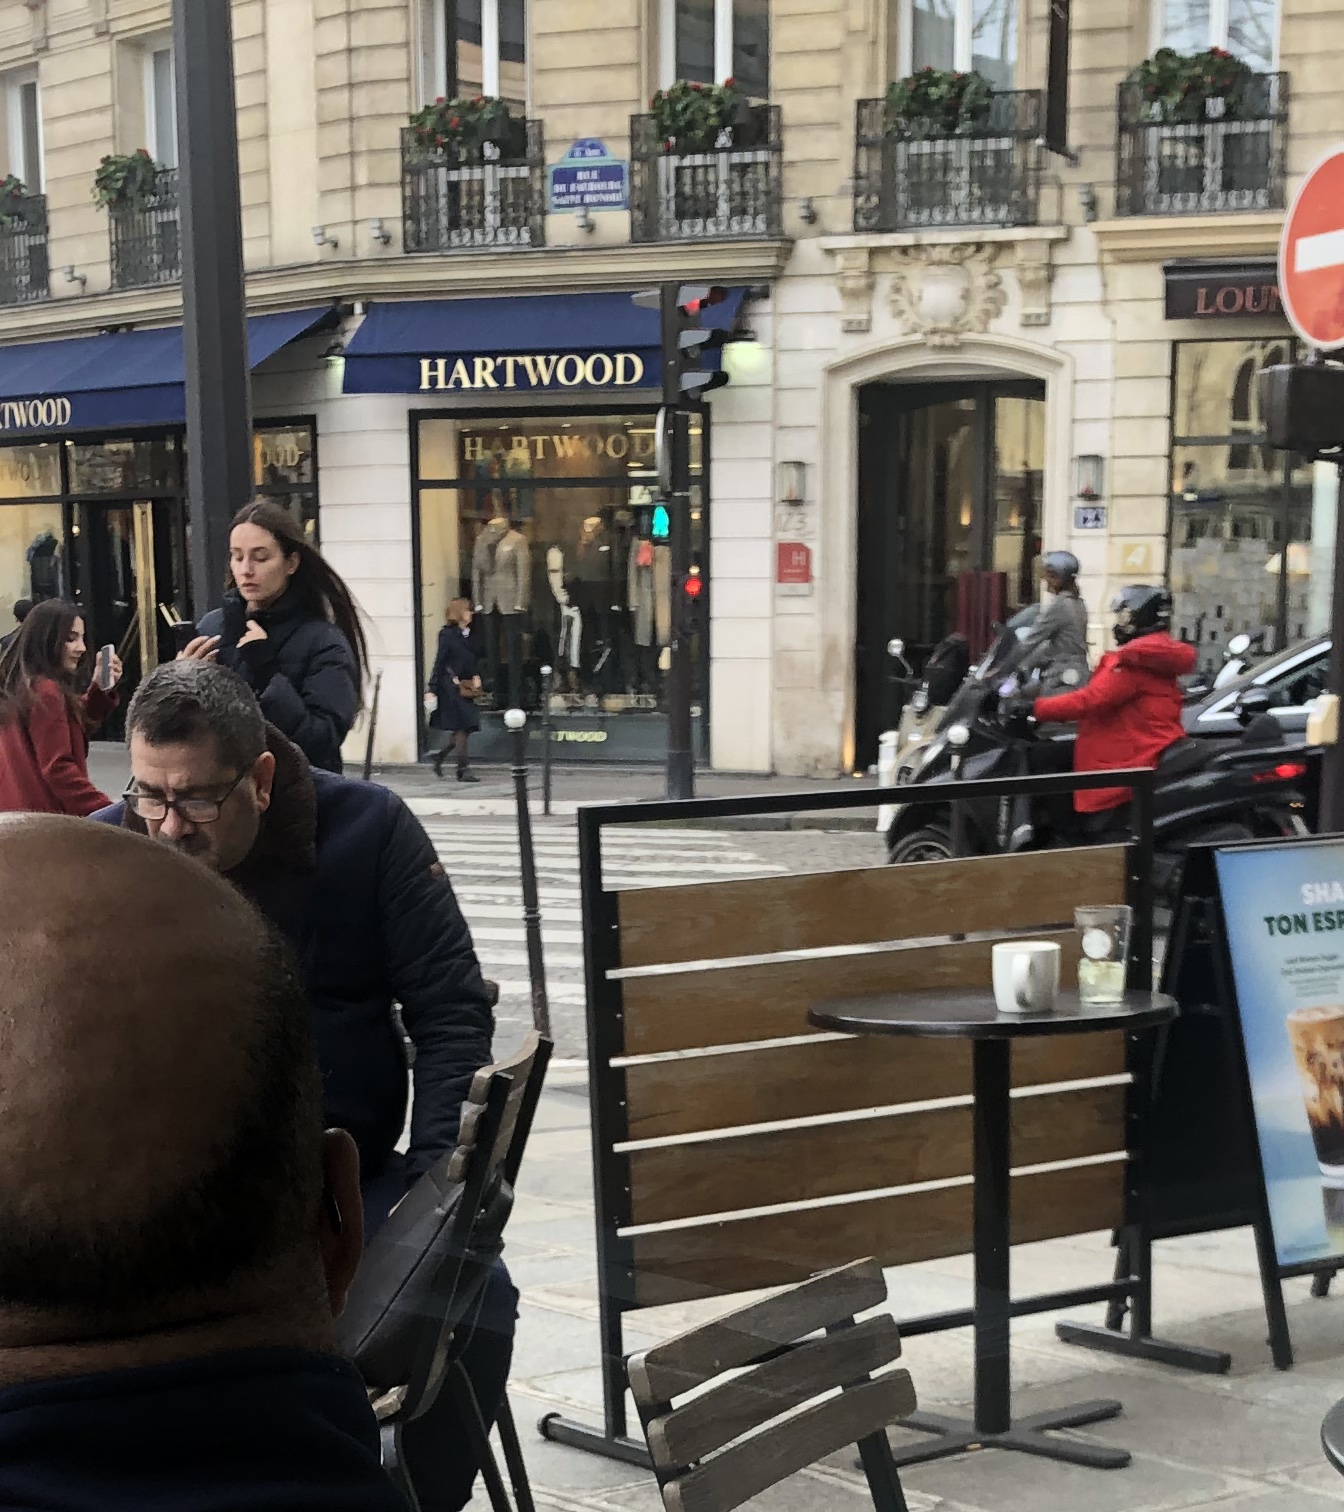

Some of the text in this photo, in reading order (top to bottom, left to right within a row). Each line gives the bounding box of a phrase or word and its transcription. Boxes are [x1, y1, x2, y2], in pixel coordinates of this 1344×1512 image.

[1193, 285, 1281, 314] LOUN
[419, 352, 644, 389] HARTWOOD
[1263, 913, 1309, 937] TON
